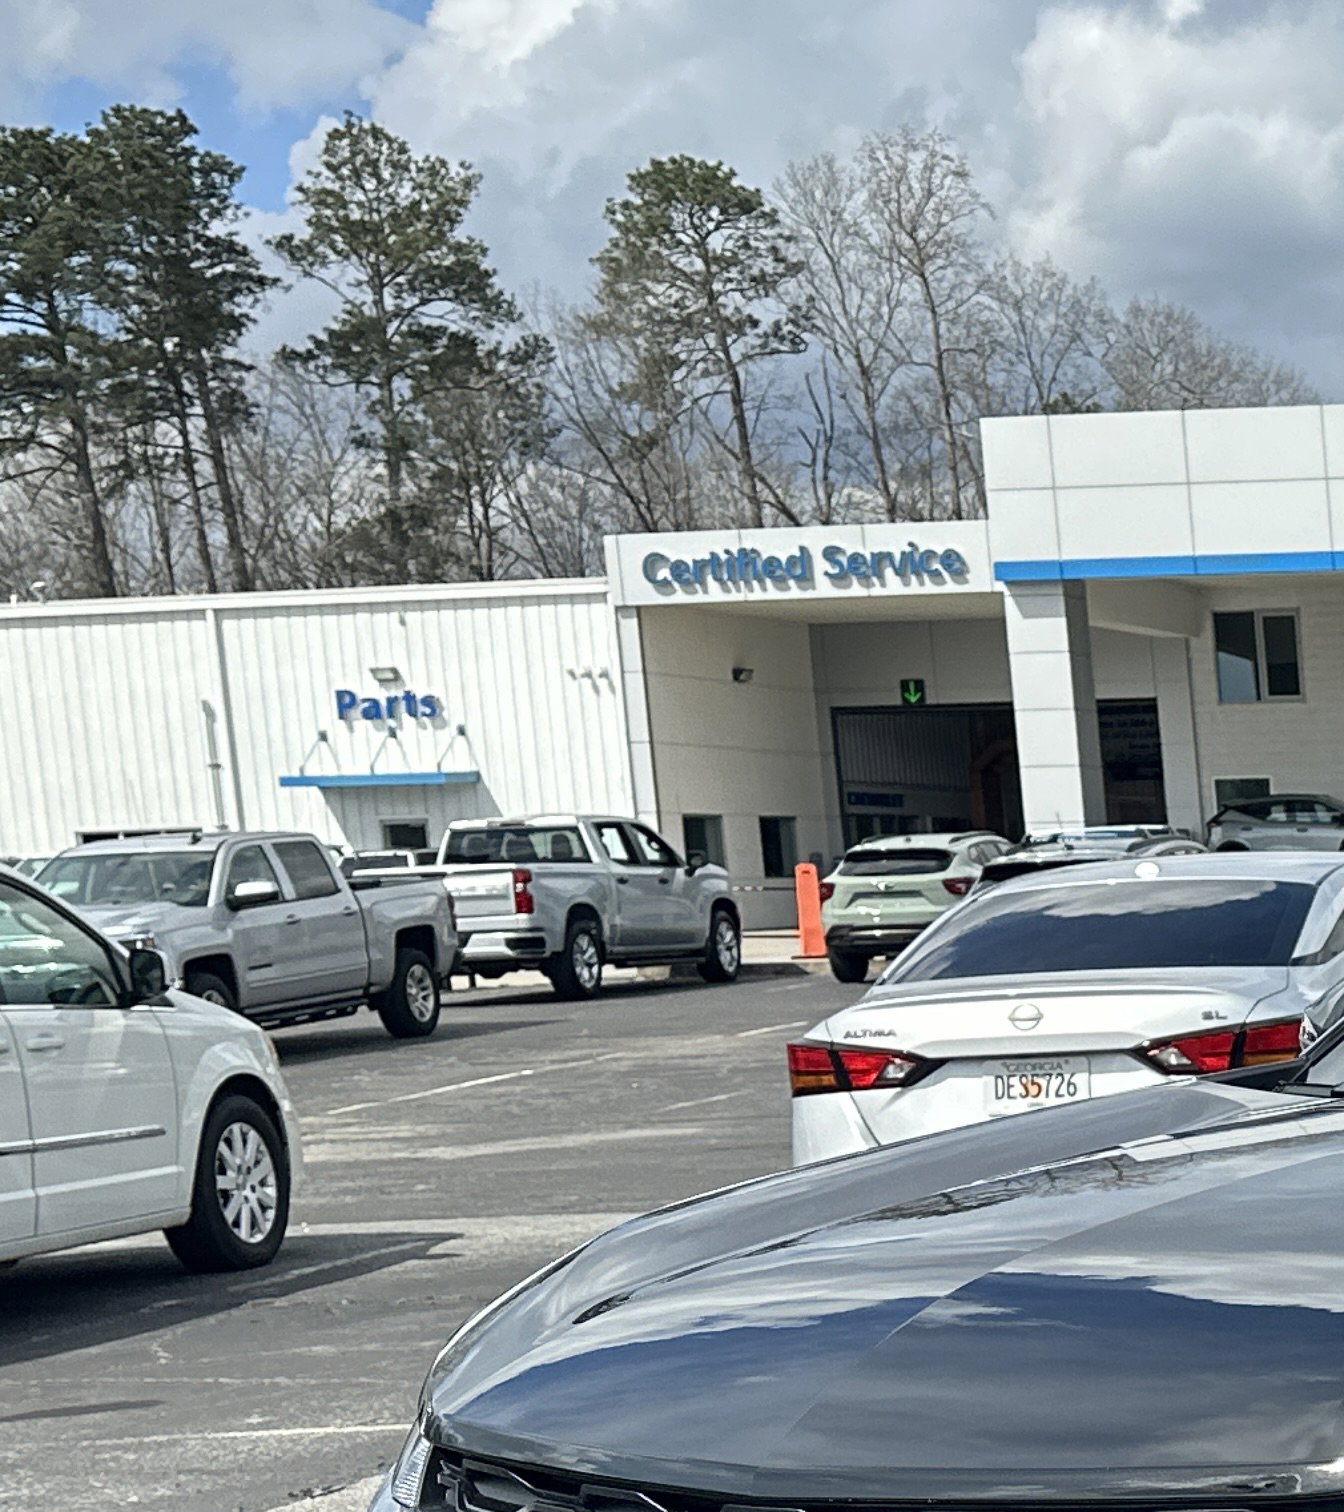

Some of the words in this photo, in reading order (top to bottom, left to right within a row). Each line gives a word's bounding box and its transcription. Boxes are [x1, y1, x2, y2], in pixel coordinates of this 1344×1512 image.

[642, 545, 814, 585] Certified
[822, 541, 969, 579] Service
[335, 689, 438, 721] Parts
